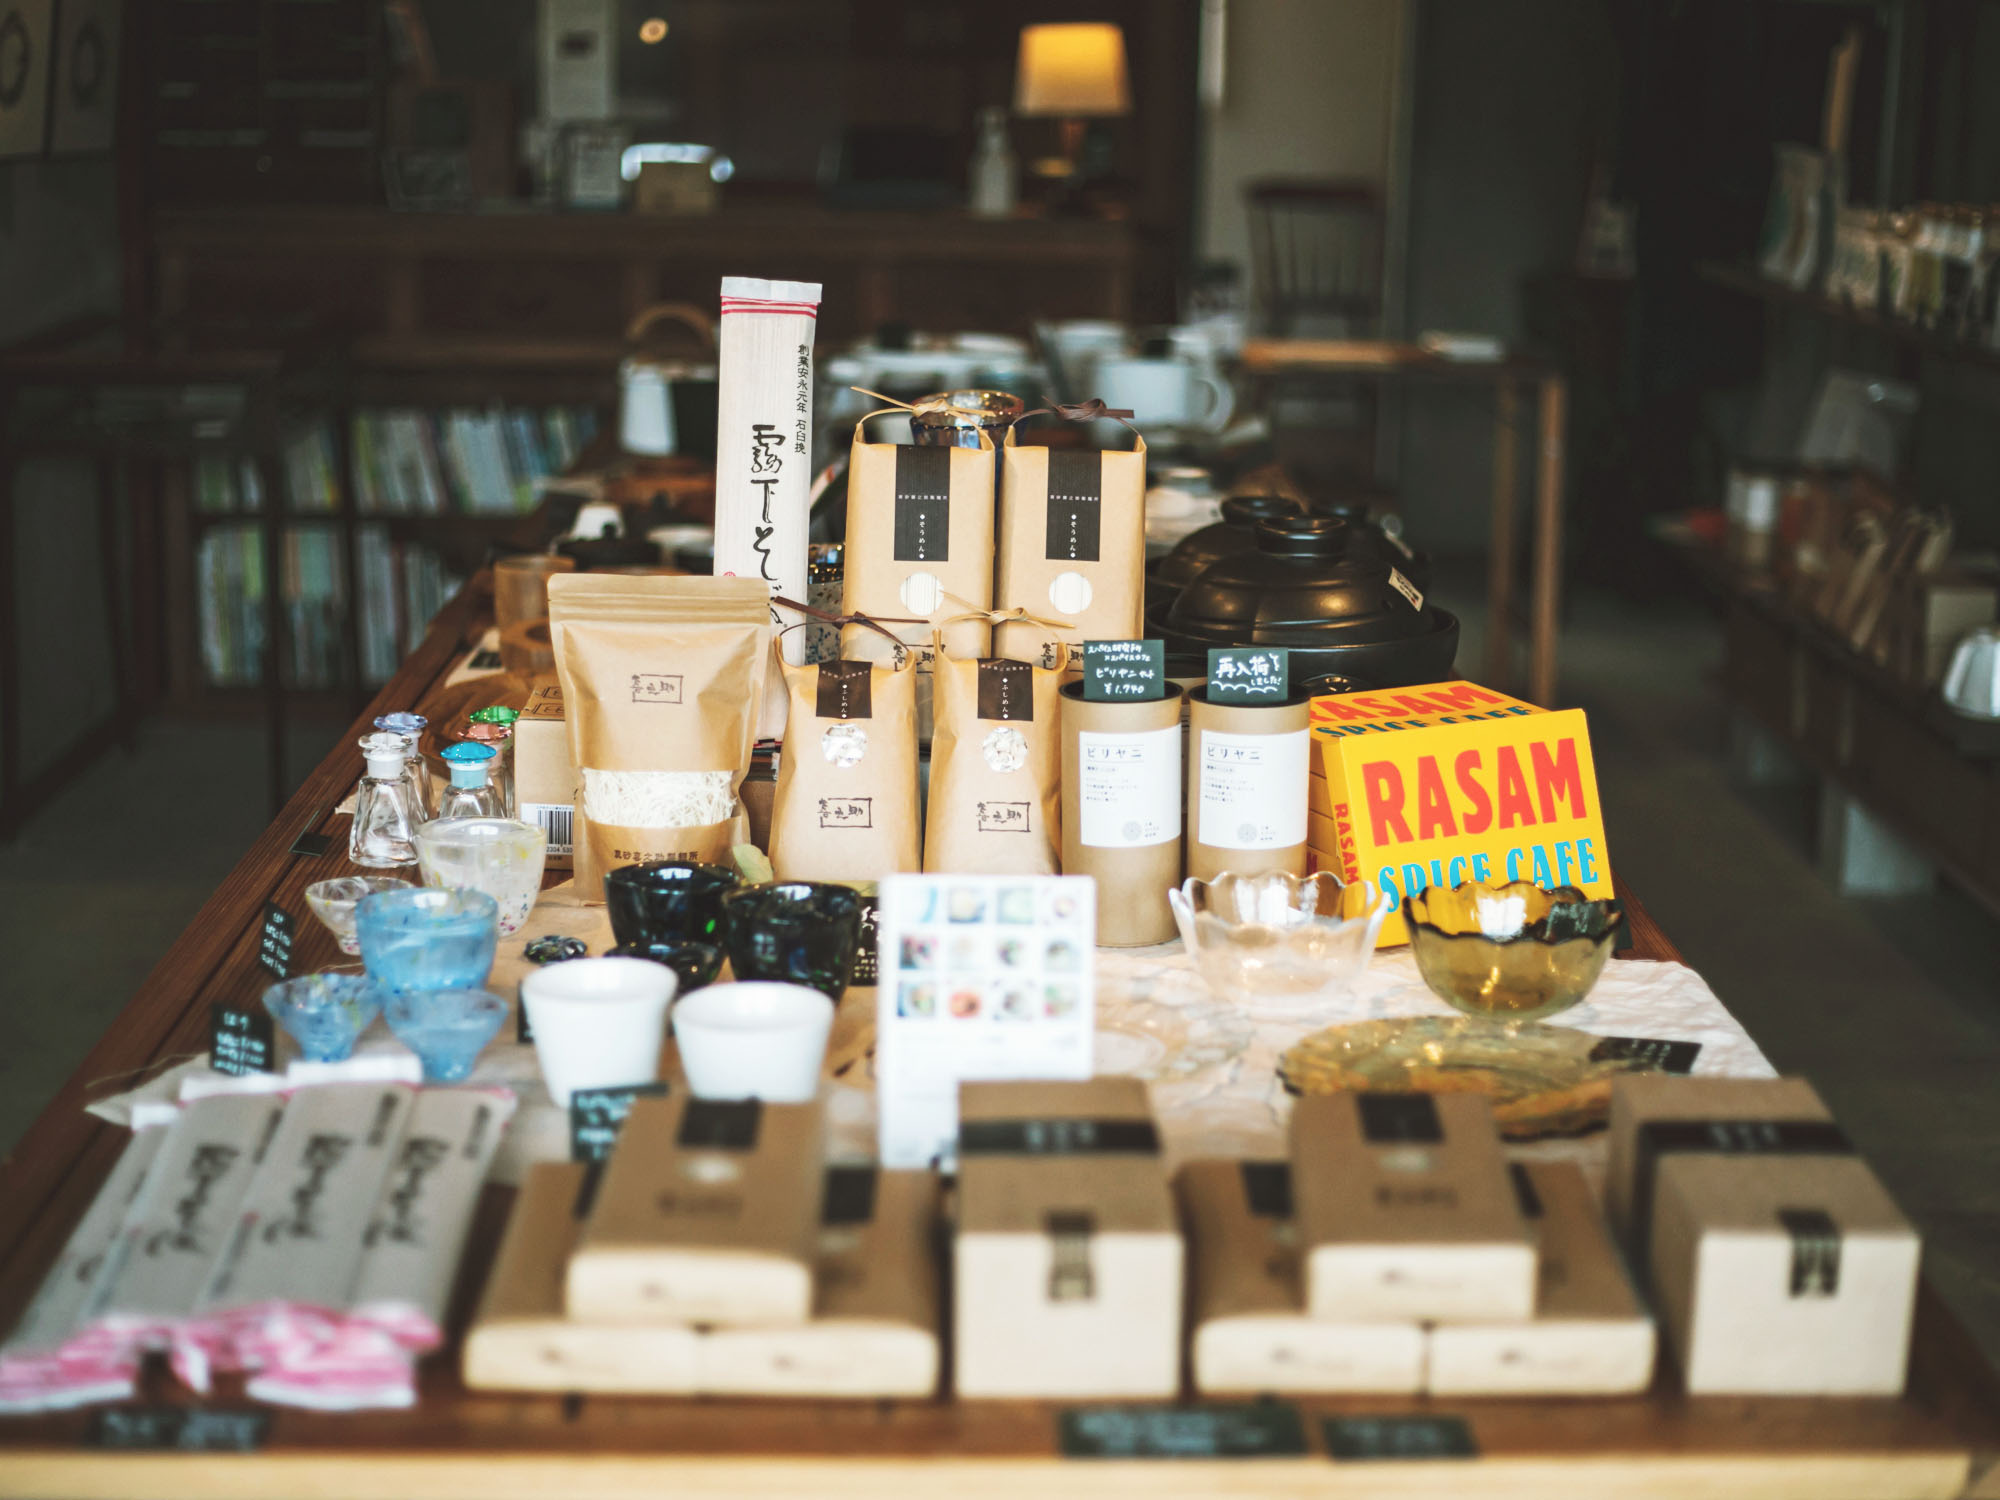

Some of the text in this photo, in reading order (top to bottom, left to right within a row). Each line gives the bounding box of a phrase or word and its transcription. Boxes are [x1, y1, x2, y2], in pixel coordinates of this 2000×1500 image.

[796, 344, 809, 413] 創業安永元年
[1215, 656, 1270, 679] 再入荷
[1087, 747, 1142, 759] ビリヤニ
[1207, 746, 1260, 760] ビリヤニ
[1361, 737, 1587, 847] RASAM
[1334, 803, 1360, 886] RASAM
[1506, 837, 1599, 891] CAFE
